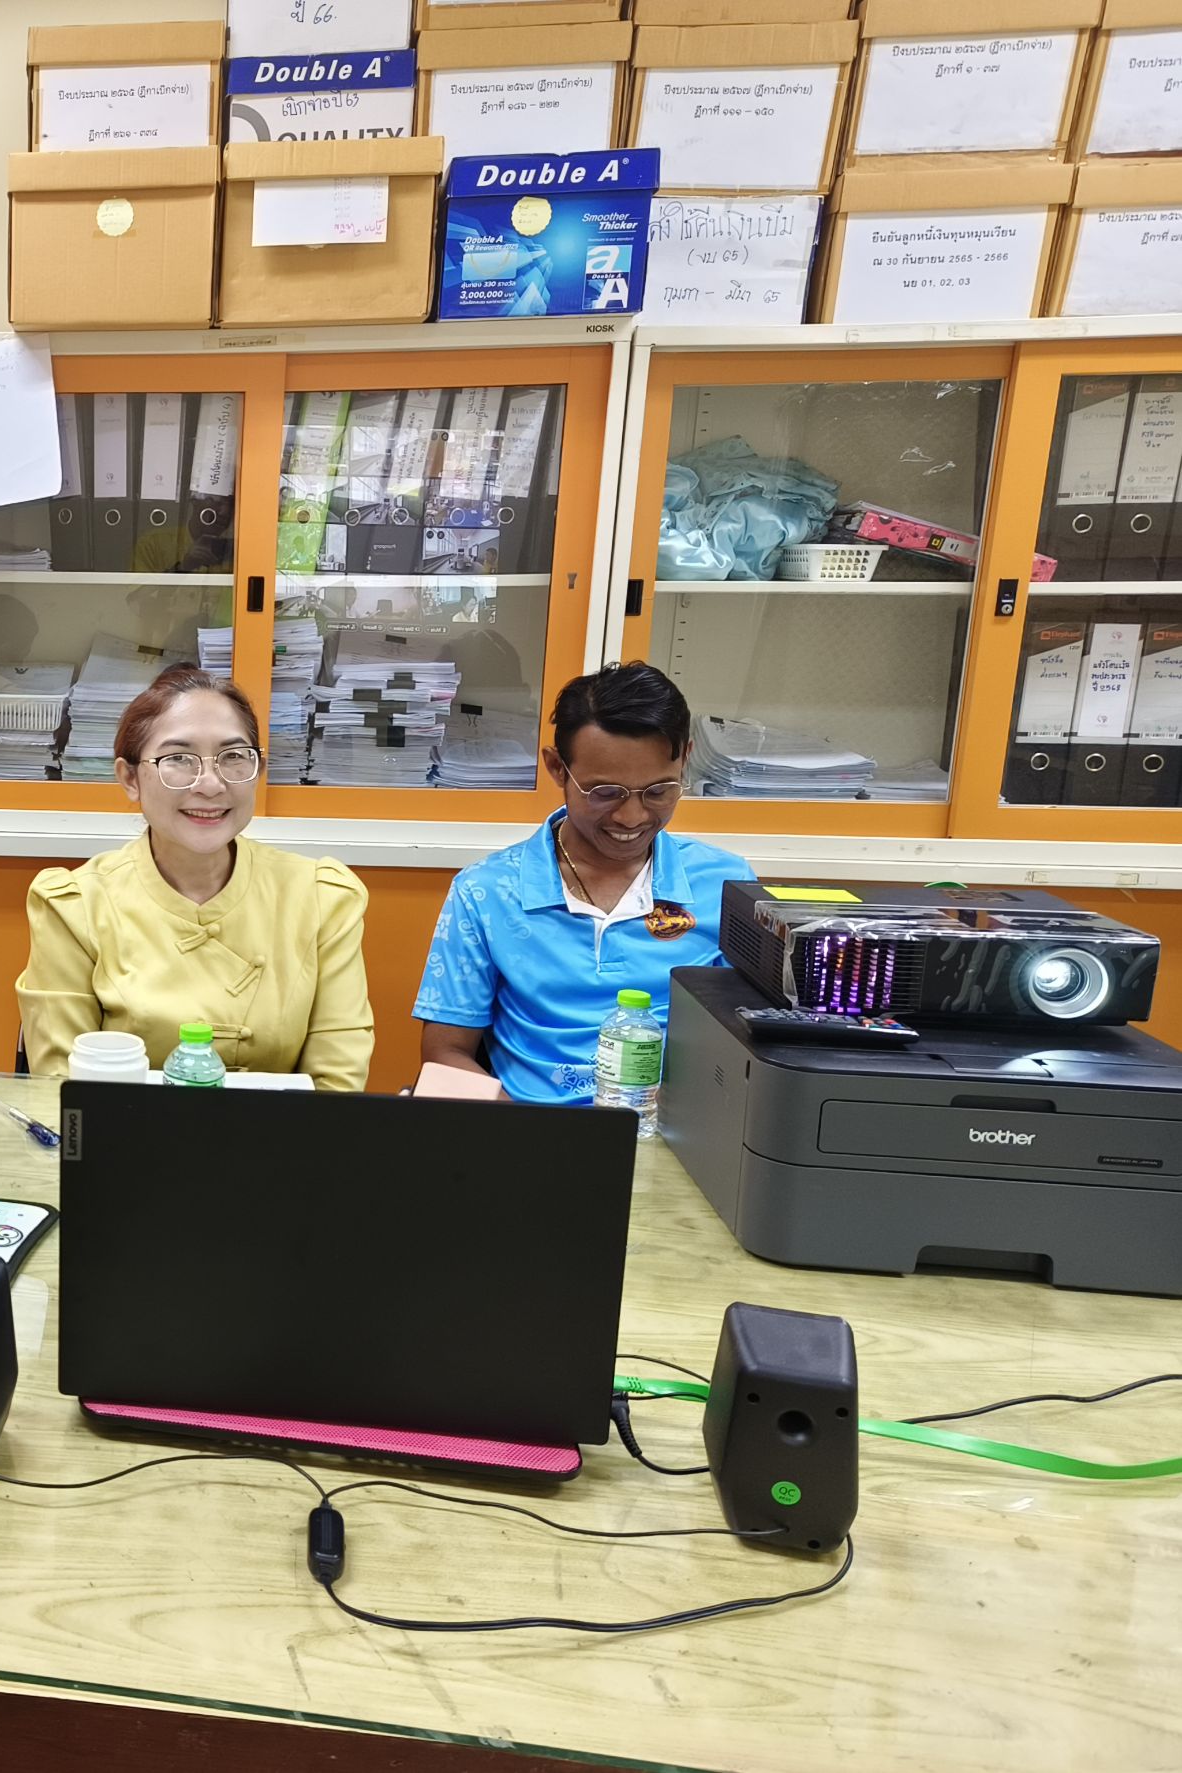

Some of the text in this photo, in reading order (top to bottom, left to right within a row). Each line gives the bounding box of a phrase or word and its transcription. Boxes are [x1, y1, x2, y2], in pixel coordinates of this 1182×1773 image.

[255, 59, 353, 83] Double
[476, 162, 587, 187] Double
[582, 212, 630, 223] Smoother
[598, 221, 638, 231] Thicker
[465, 235, 503, 244] Double A
[886, 258, 898, 266] 30
[902, 253, 945, 265] กันยายน
[948, 254, 973, 263] 2565
[459, 290, 503, 299] 3,000,000
[586, 325, 615, 333] KIOSK
[67, 1113, 77, 1157] Lenovo
[969, 1128, 1036, 1145] brother
[779, 1486, 796, 1497] QC
